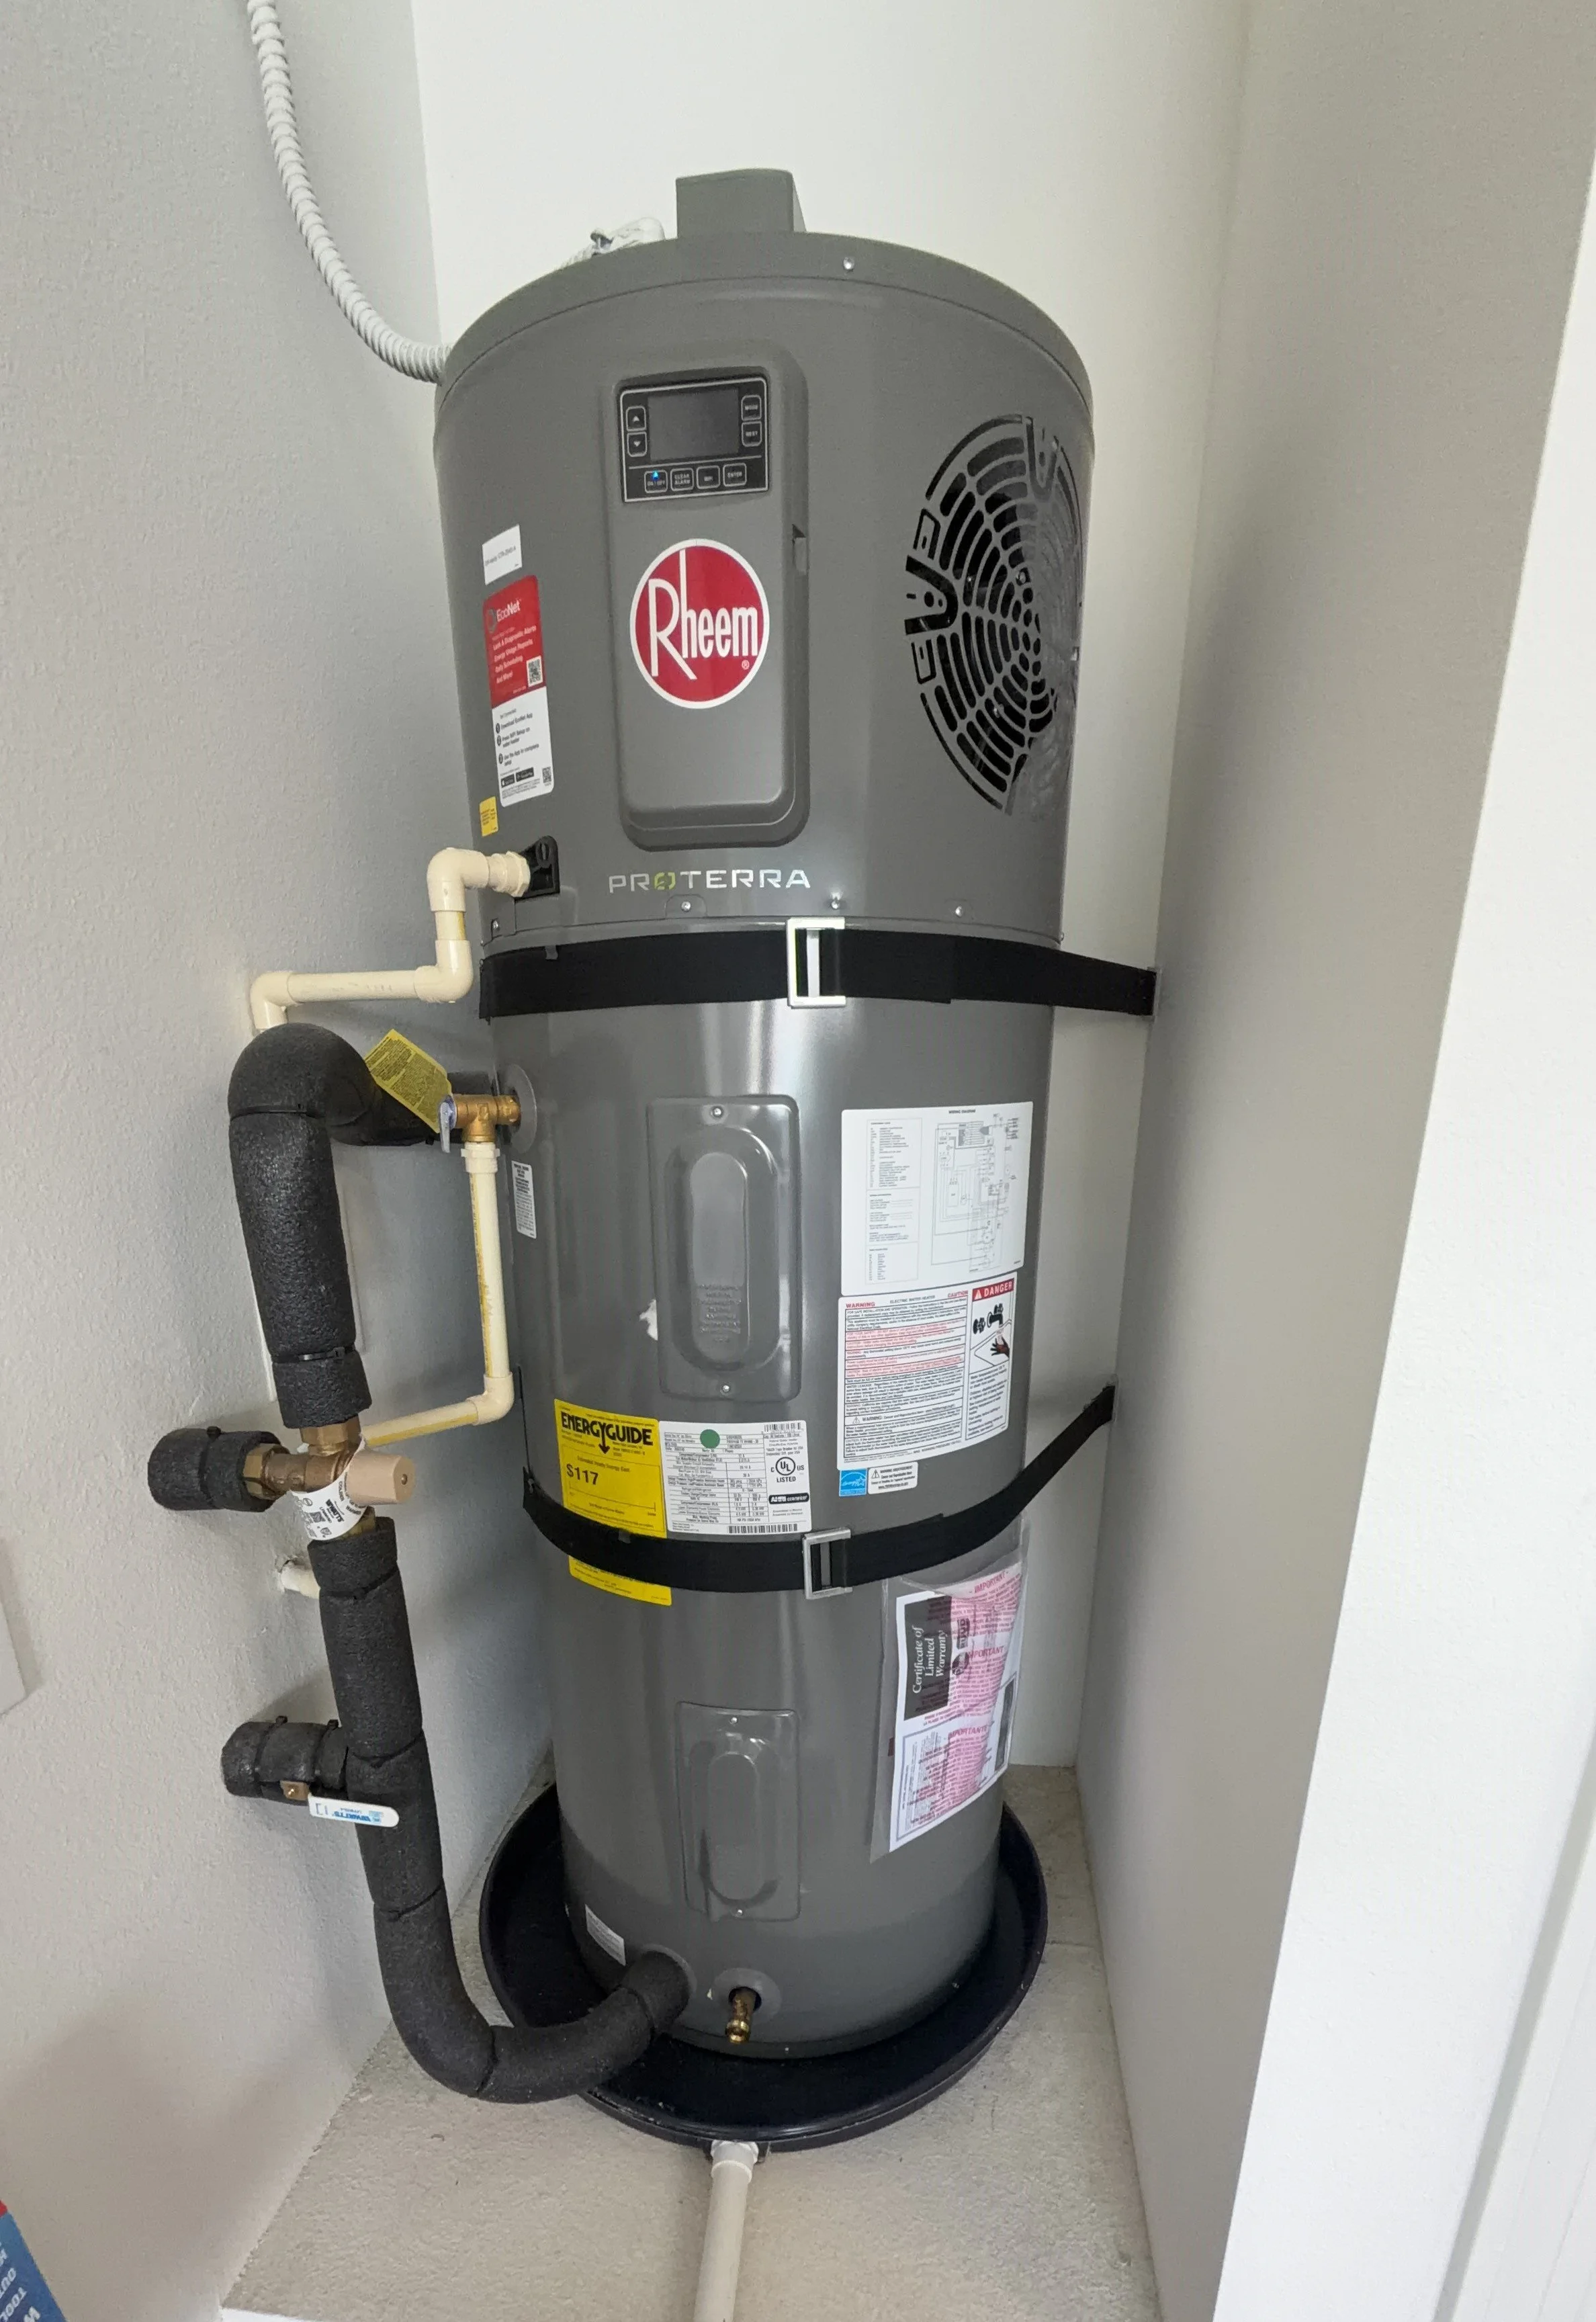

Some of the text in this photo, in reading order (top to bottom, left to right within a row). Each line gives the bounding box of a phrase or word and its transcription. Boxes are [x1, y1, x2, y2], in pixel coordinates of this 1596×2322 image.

[496, 599, 521, 622] EcoNet
[648, 549, 758, 680] Rheem
[609, 869, 811, 894] PROTERRA
[984, 1281, 1012, 1297] DANGER
[566, 1463, 598, 1486] $117
[780, 1461, 791, 1472] UL
[974, 1570, 1006, 1594] IMPORTANT
[912, 1625, 925, 1693] Certificate of
[924, 1637, 935, 1676] Limited
[935, 1629, 948, 1677] Warranty
